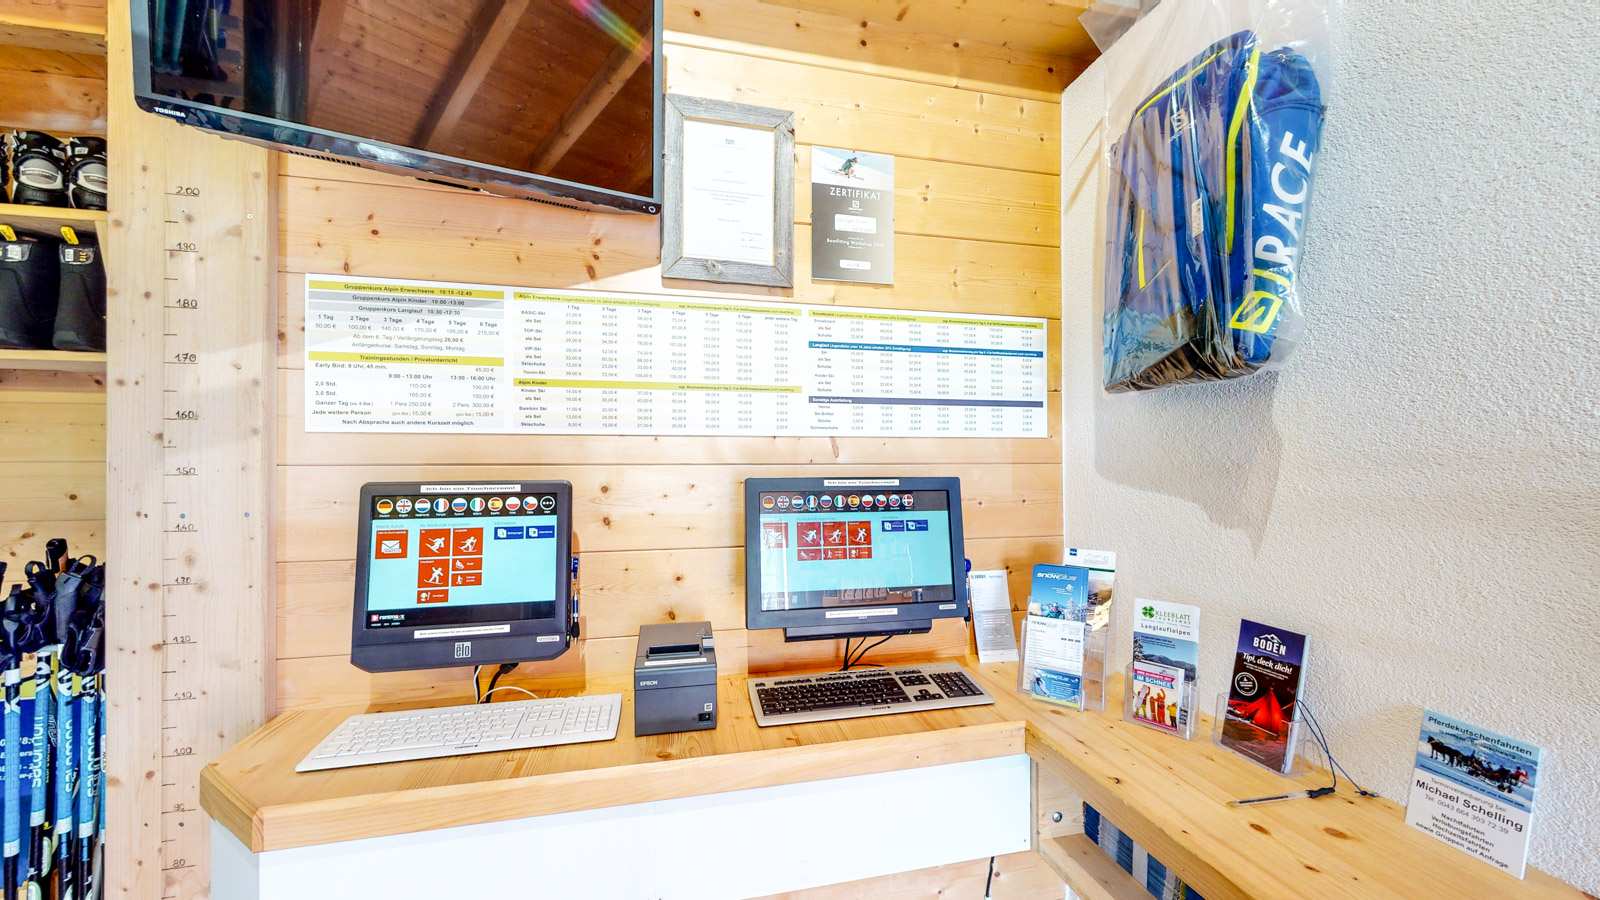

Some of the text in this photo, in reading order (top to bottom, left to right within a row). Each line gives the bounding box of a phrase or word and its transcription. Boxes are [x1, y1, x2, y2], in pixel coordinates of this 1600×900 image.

[154, 106, 186, 118] TOSHIBA
[829, 187, 882, 201] ZERTIFIKAT
[1255, 131, 1312, 268] RACE
[344, 284, 383, 292] Gruppenkurs
[352, 294, 391, 302] Gruppenkurs
[1155, 610, 1191, 621] KLEEBLATT
[1141, 623, 1191, 636] Langlaufloipen
[1253, 637, 1287, 656] BODEN
[1257, 657, 1274, 669] deck
[1274, 662, 1293, 675] dich!
[1145, 677, 1172, 688] SCHNEE
[1428, 716, 1532, 757] Pferdekutschenfahrten
[1431, 777, 1494, 808] Terminvereinbarung
[1415, 779, 1459, 804] Michael
[1462, 799, 1523, 832] Schelling
[1437, 799, 1455, 811] 0043
[1456, 808, 1469, 817] 664
[1471, 814, 1485, 825] 303
[1487, 821, 1497, 830] 72
[1498, 826, 1509, 835] 39
[1441, 813, 1485, 836] Nachtfahrten
[1431, 815, 1494, 848] Verlobungsfahrten
[1432, 822, 1490, 853] Hochzeitsfahrten
[1416, 822, 1509, 869] sowie Gruppen auf Anfrage
